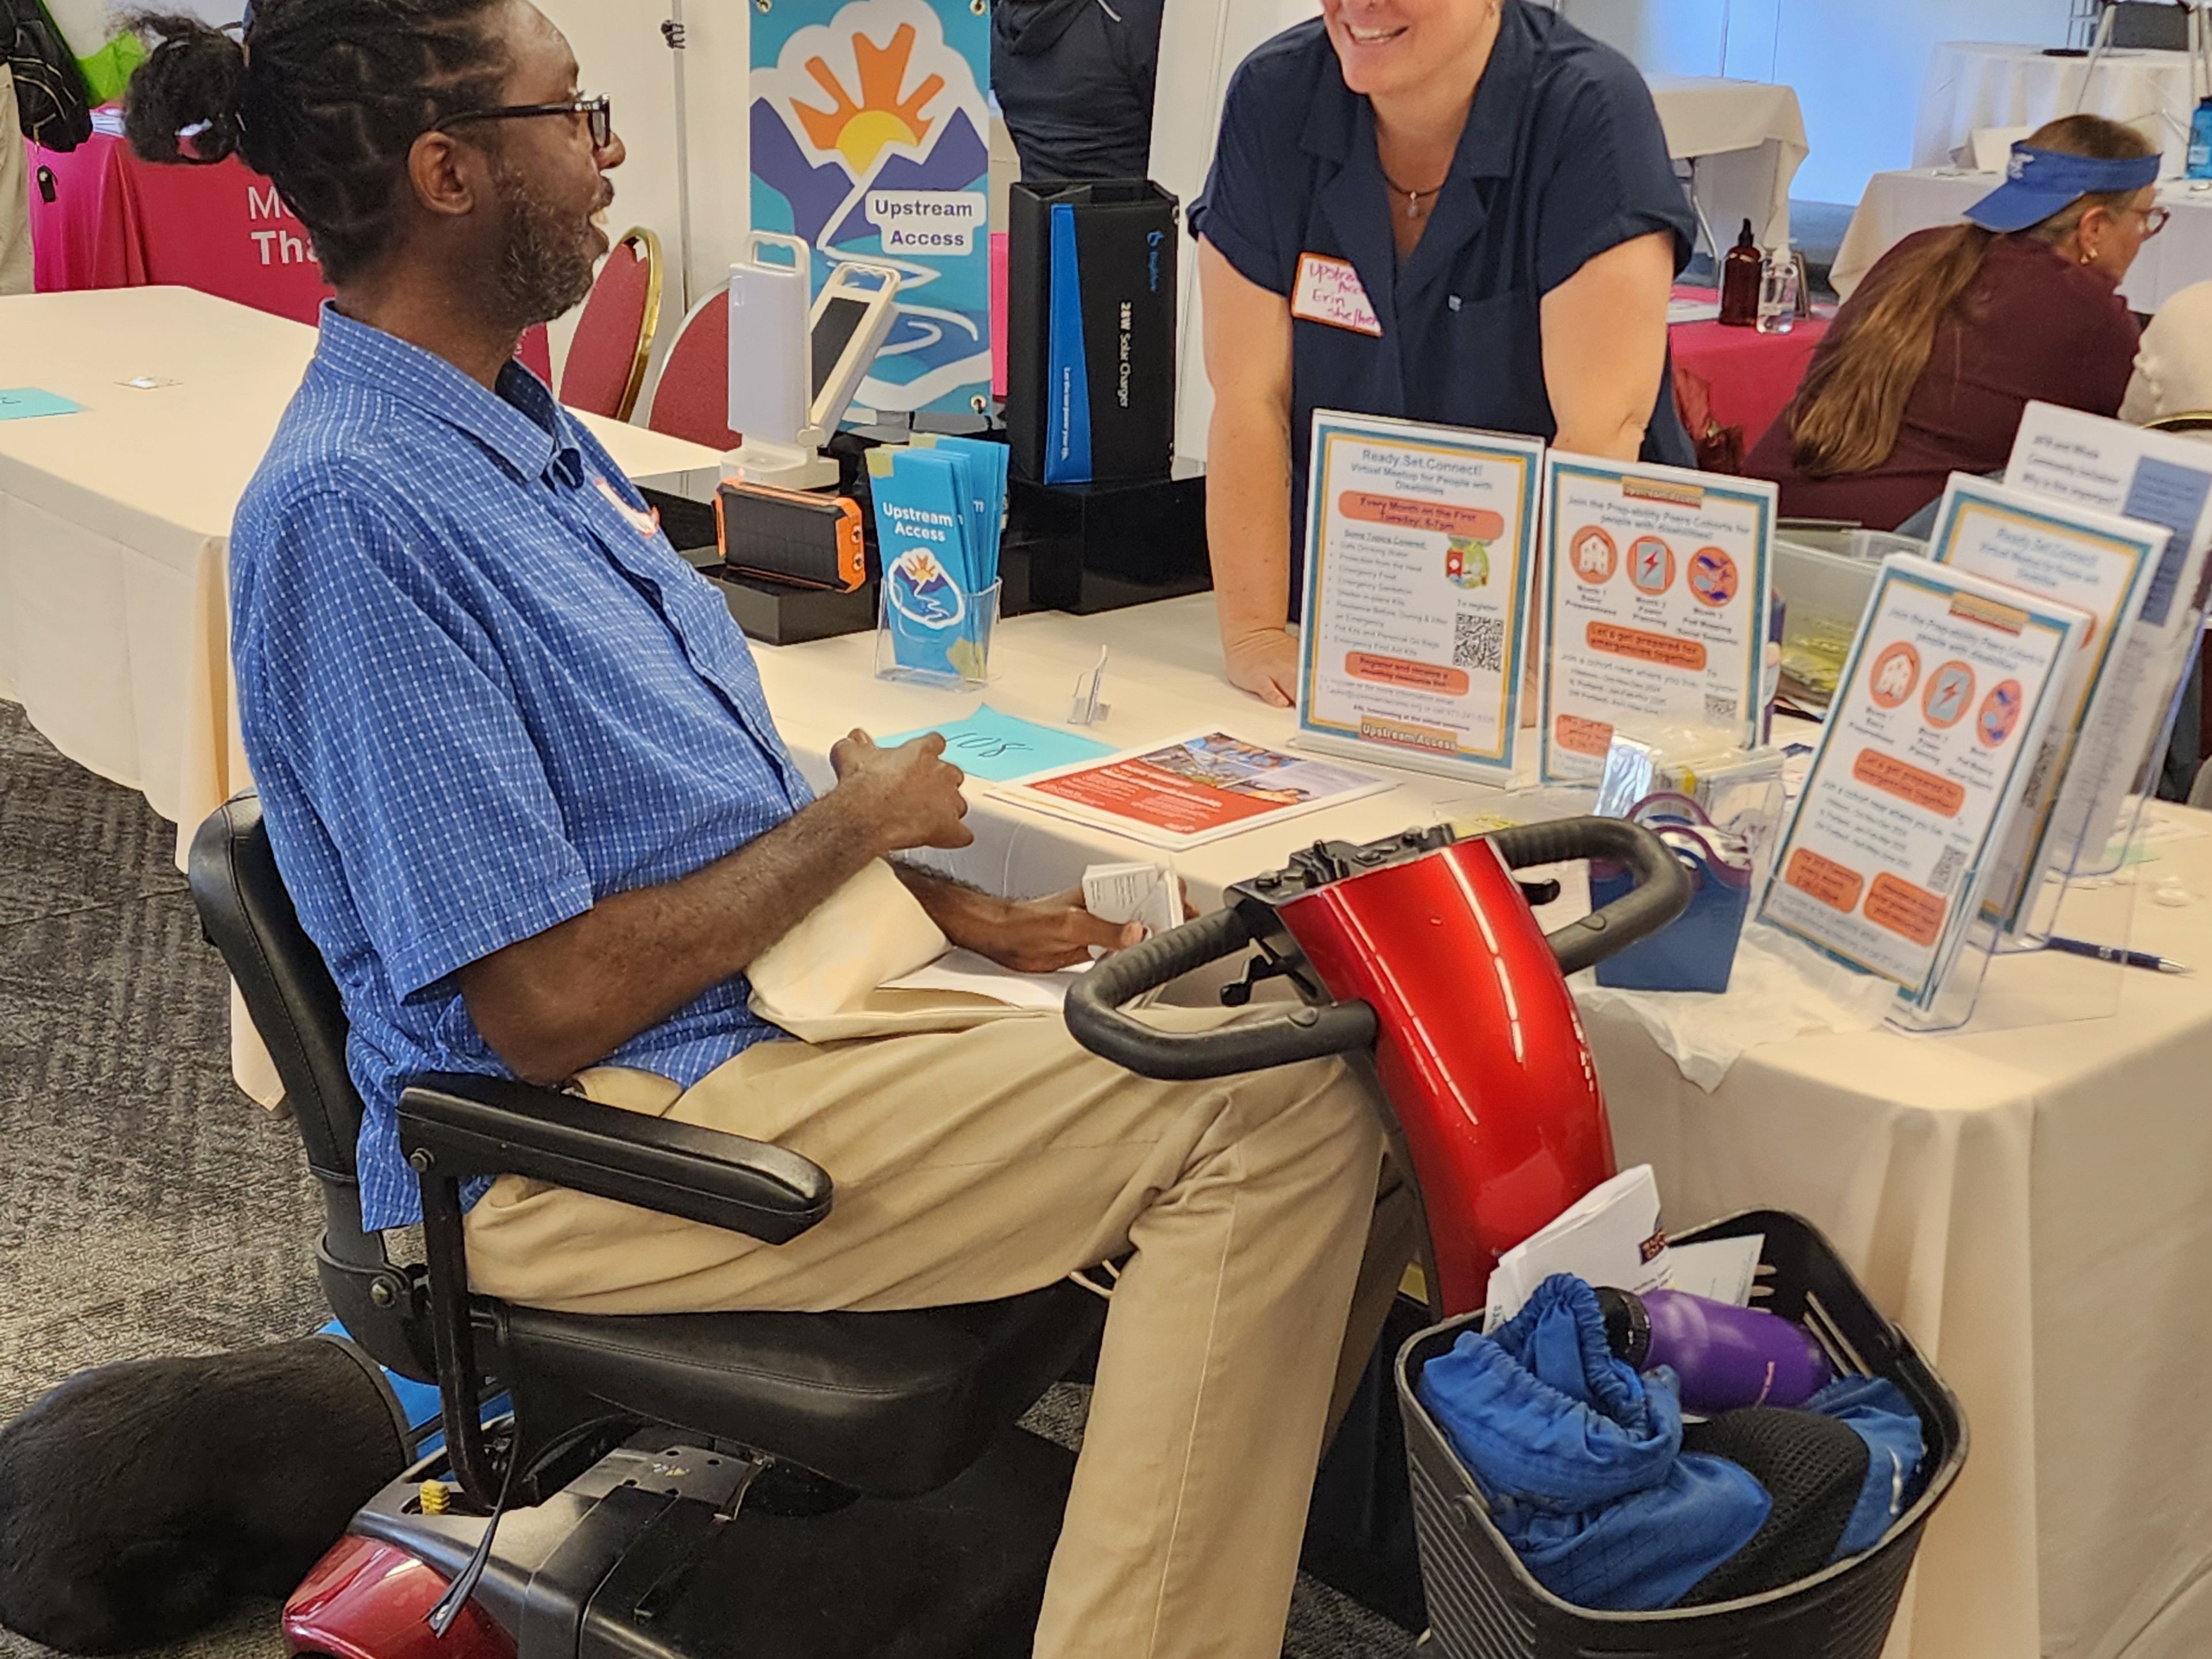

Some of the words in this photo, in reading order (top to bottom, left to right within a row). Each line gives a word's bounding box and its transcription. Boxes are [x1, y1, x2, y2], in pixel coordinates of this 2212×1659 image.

[875, 199, 972, 219] Upstream
[891, 230, 964, 246] Access
[1312, 288, 1344, 308] Erin
[1120, 302, 1132, 329] 28W
[1119, 333, 1131, 361] Solar
[1118, 362, 1131, 408] Charger
[882, 501, 953, 528] Upstream
[895, 521, 946, 542] Access
[1362, 723, 1413, 741] Upstream
[1416, 733, 1457, 749] Access
